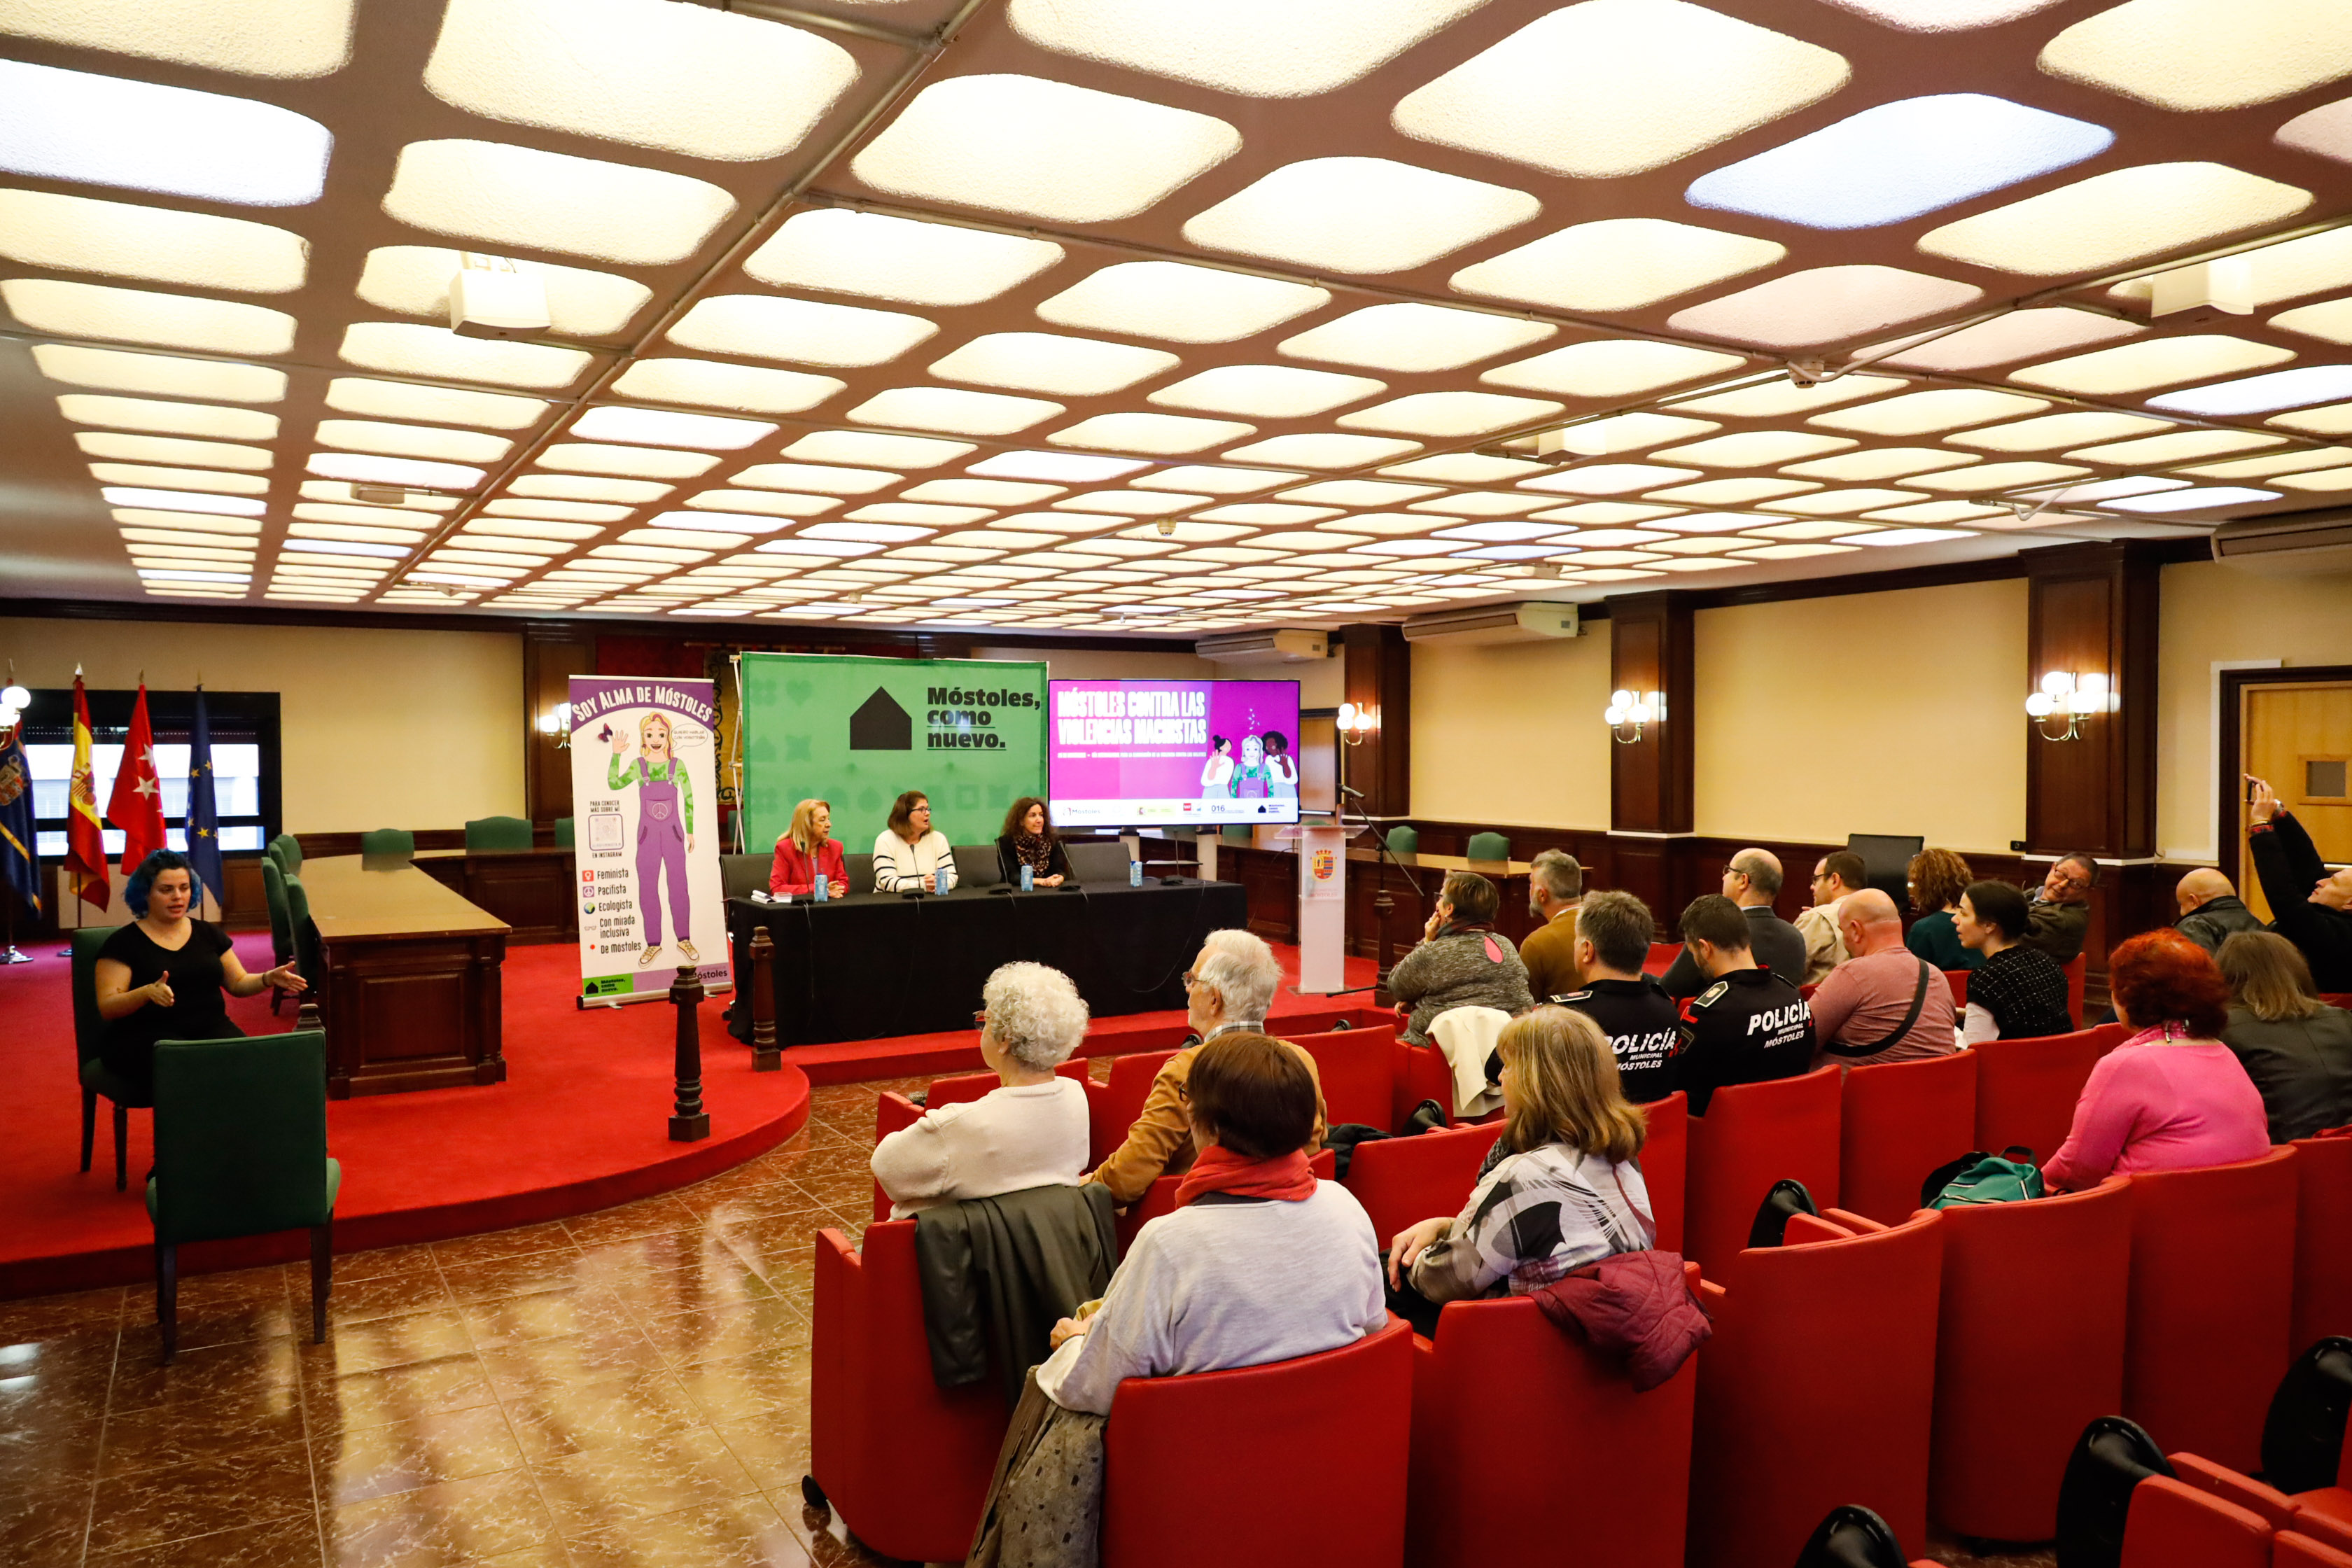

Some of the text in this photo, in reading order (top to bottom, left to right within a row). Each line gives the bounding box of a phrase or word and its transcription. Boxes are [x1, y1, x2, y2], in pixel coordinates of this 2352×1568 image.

[572, 685, 712, 722] SOY ALMA DE MÓSTOLES
[927, 687, 1040, 710] Móstoles,
[1058, 687, 1205, 717] MÓSTOLES CONTRA LAS
[927, 710, 992, 725] como
[927, 732, 1006, 748] nuevo.
[597, 868, 629, 879] Feminista
[598, 883, 626, 895] Pacifista
[598, 899, 633, 912] Ecologista
[600, 915, 635, 927] Con mirada
[600, 927, 629, 939] inclusiva
[601, 945, 609, 954] De
[694, 970, 727, 979] óstoles
[1747, 998, 1811, 1036] POLICÍA
[1778, 1023, 1804, 1035] MUNICIPAL
[1764, 1030, 1805, 1049] MÓSTOLES
[1629, 1052, 1662, 1060] MUNICIPAL
